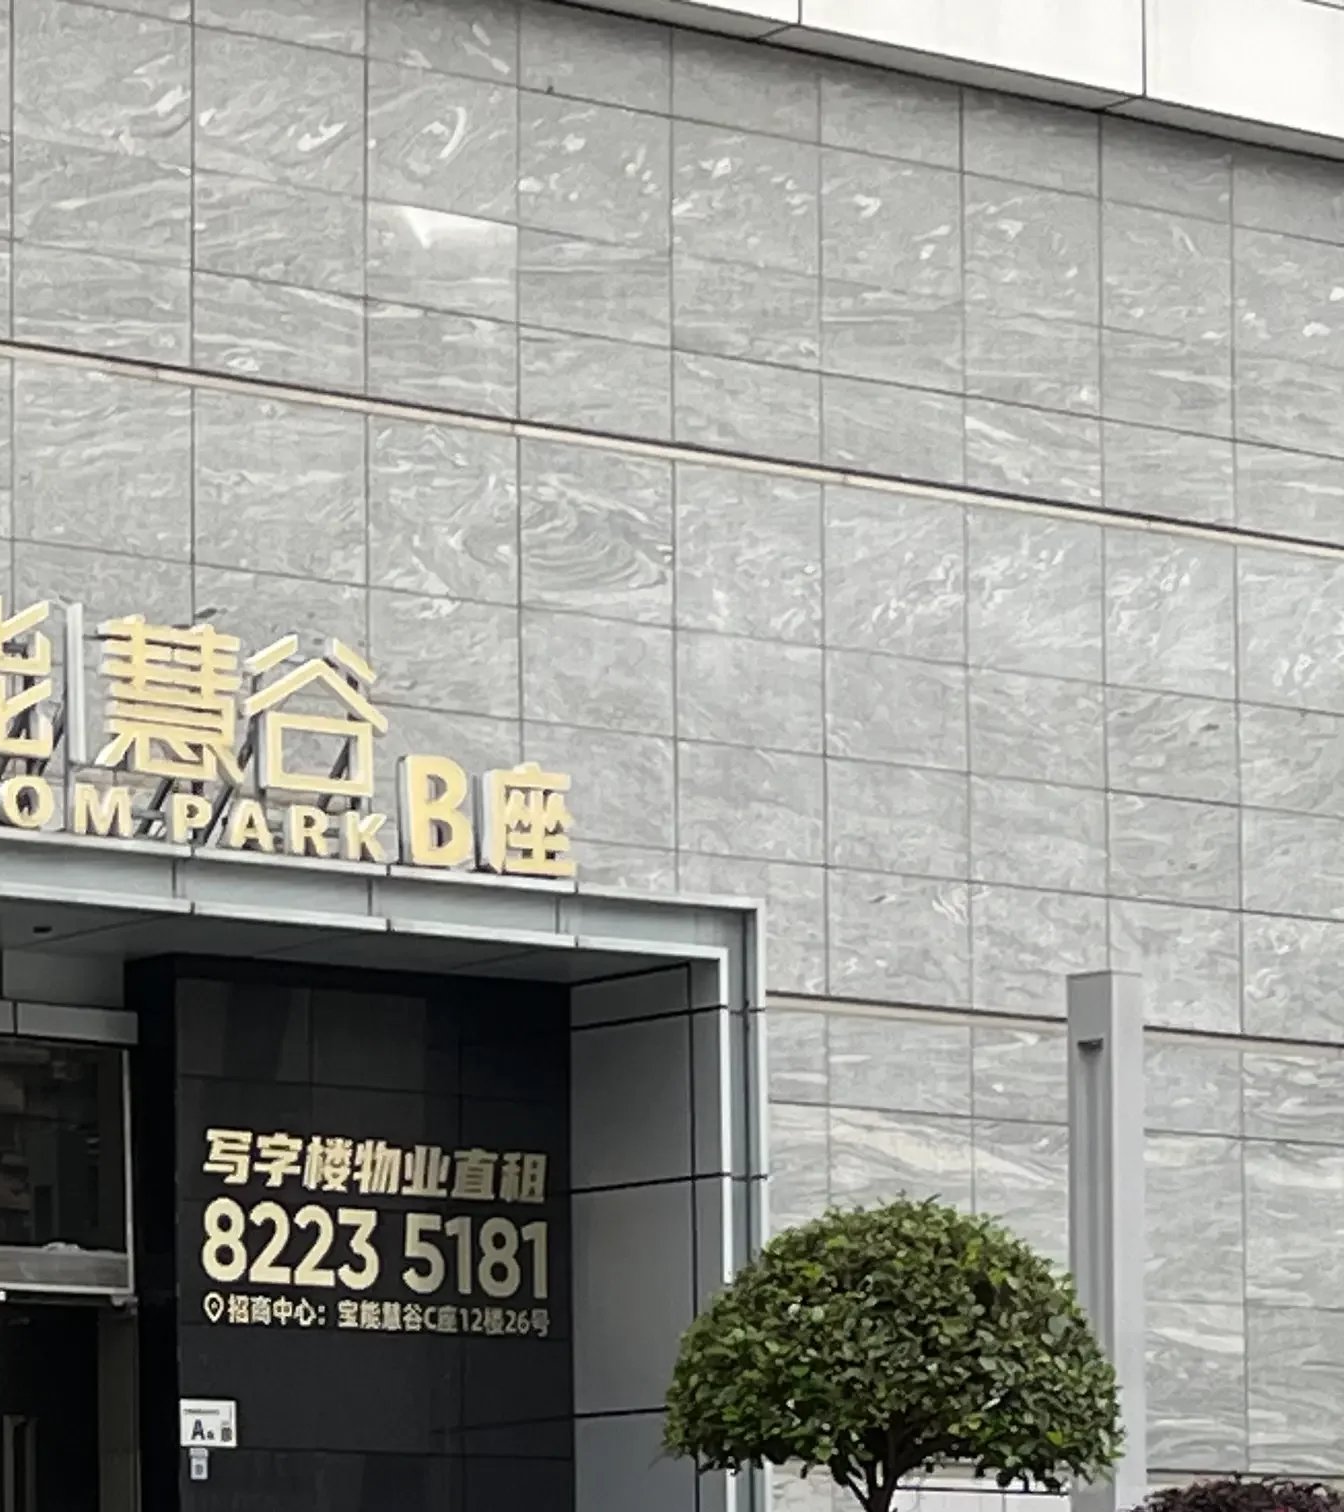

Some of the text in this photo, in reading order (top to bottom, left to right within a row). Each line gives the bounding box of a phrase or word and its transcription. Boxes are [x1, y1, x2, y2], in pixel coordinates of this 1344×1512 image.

[96, 612, 389, 797] 慧谷
[169, 792, 387, 862] PARK
[401, 754, 577, 877] B座
[203, 1128, 548, 1204] 写字楼物业直租
[202, 1196, 548, 1299] 8223 5181
